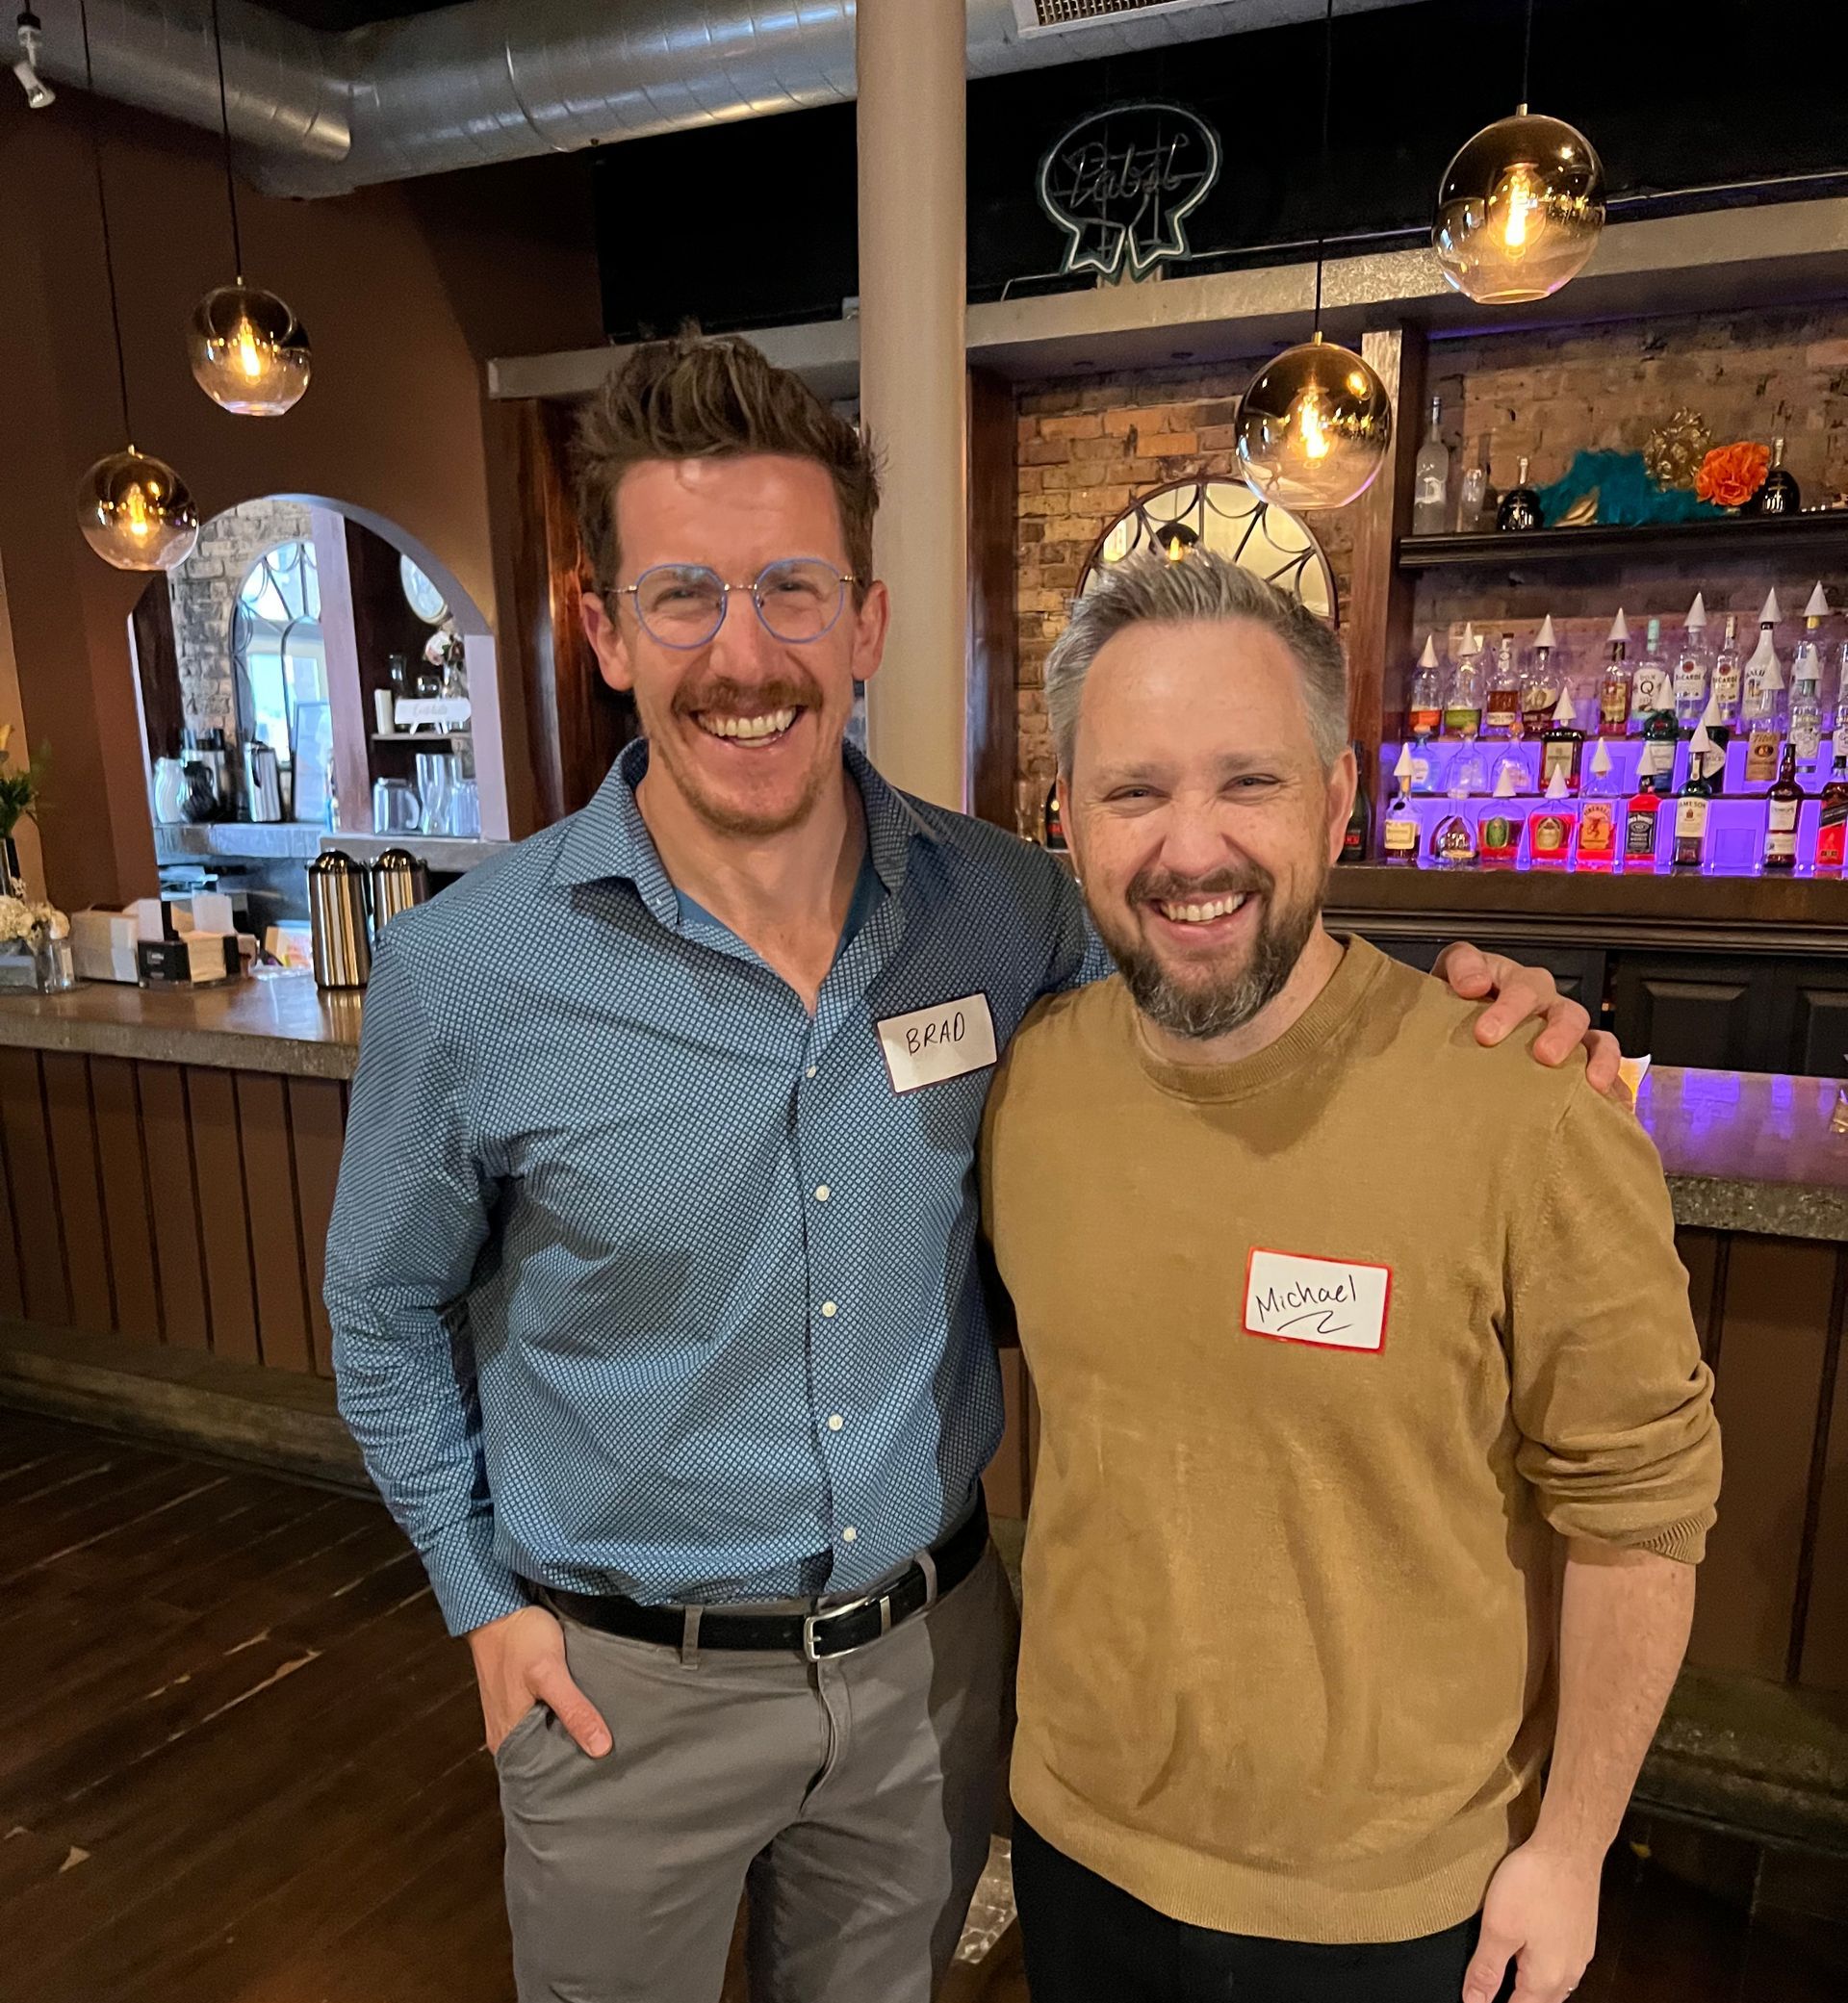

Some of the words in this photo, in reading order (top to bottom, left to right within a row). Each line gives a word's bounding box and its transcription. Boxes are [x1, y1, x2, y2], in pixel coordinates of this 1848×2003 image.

[1640, 681, 1655, 696] Q
[1680, 800, 1706, 809] AMESON
[906, 1012, 965, 1056] BRAD
[1255, 1273, 1356, 1322] Michael
